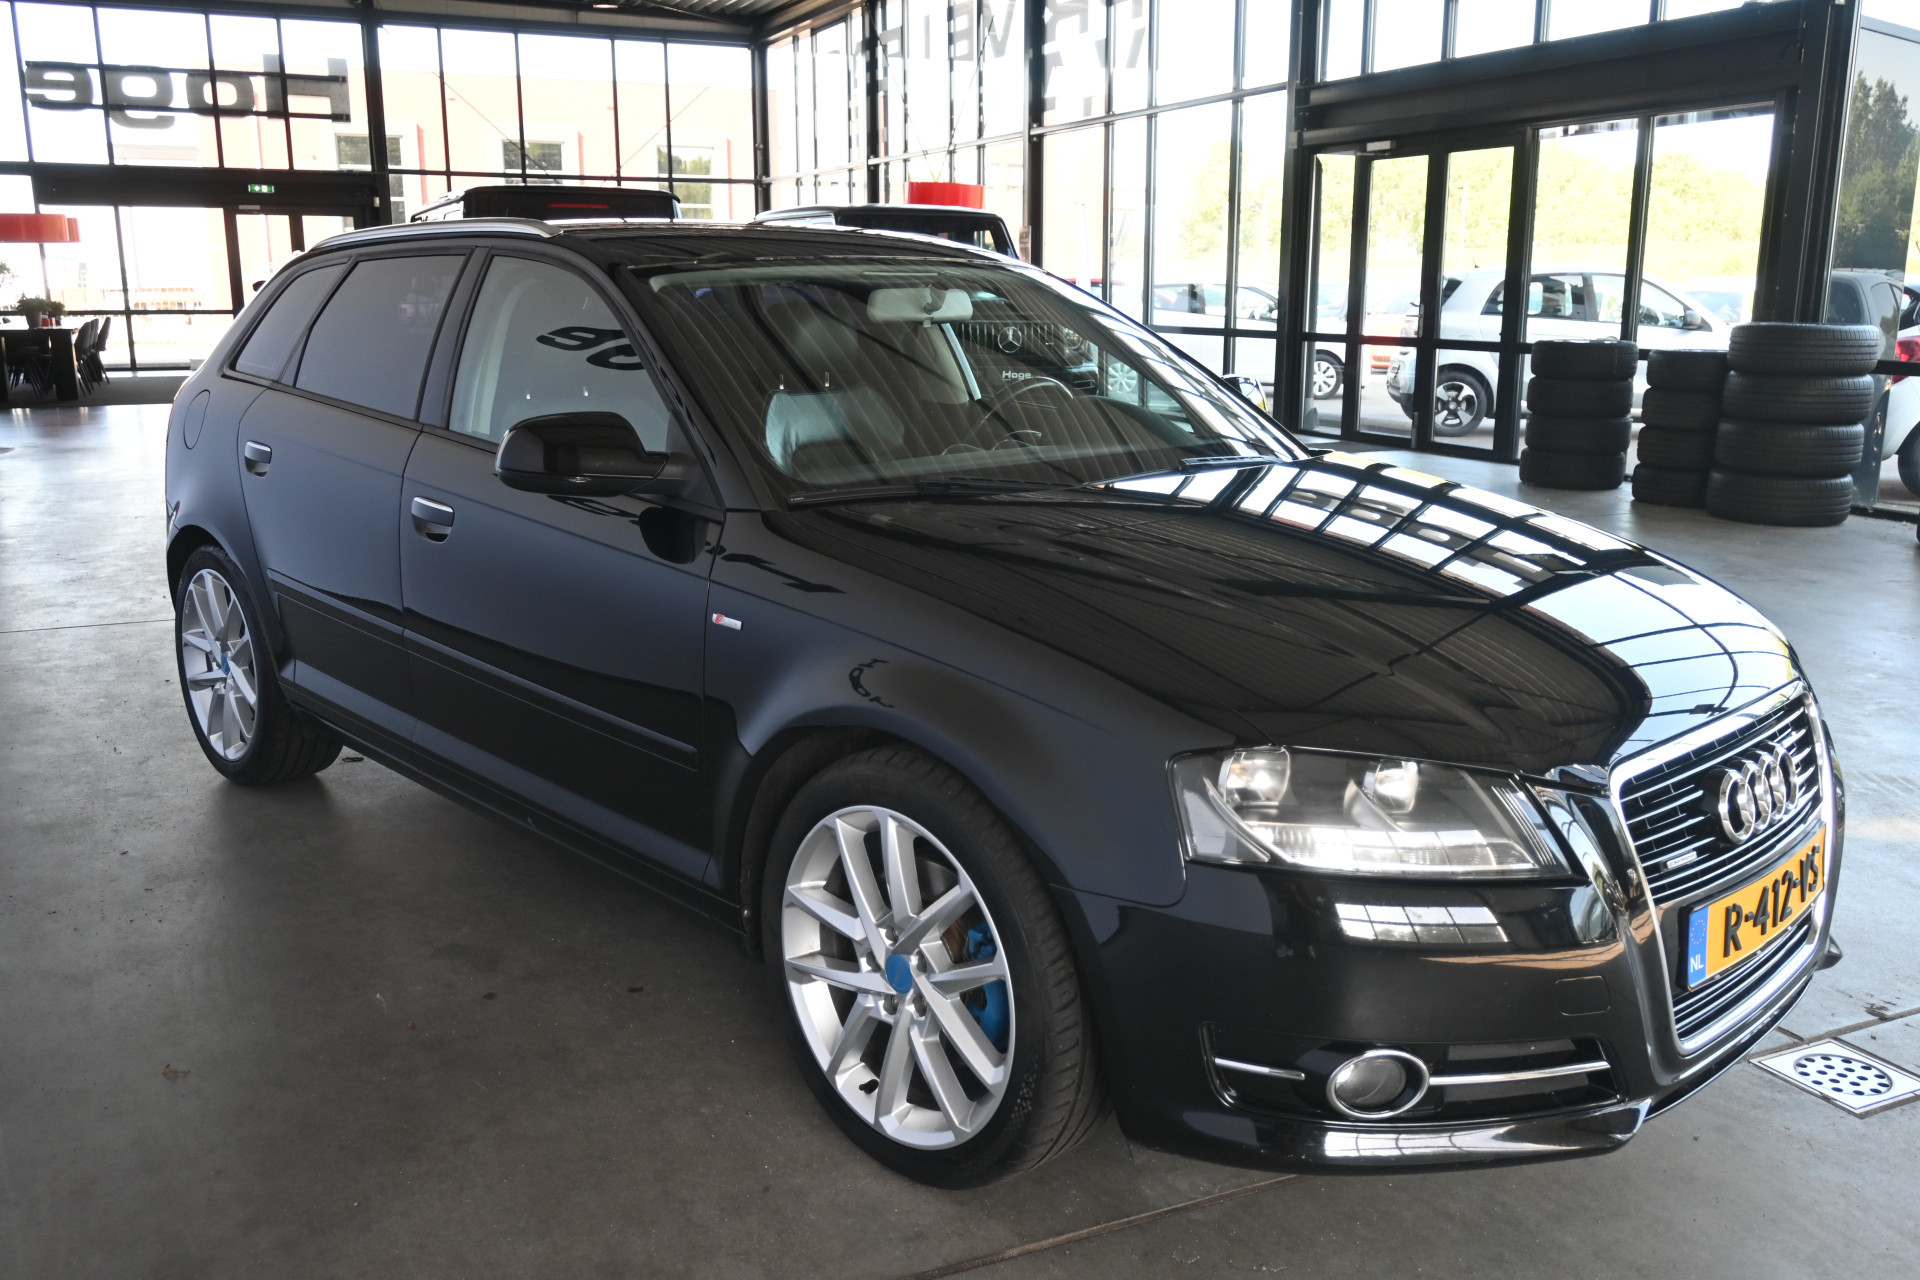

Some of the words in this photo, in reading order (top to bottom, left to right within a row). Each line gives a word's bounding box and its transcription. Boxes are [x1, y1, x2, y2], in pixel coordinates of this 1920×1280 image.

[1002, 370, 1032, 381] Hoge
[1723, 844, 1820, 958] R-412-VS
[1690, 953, 1705, 973] NL
